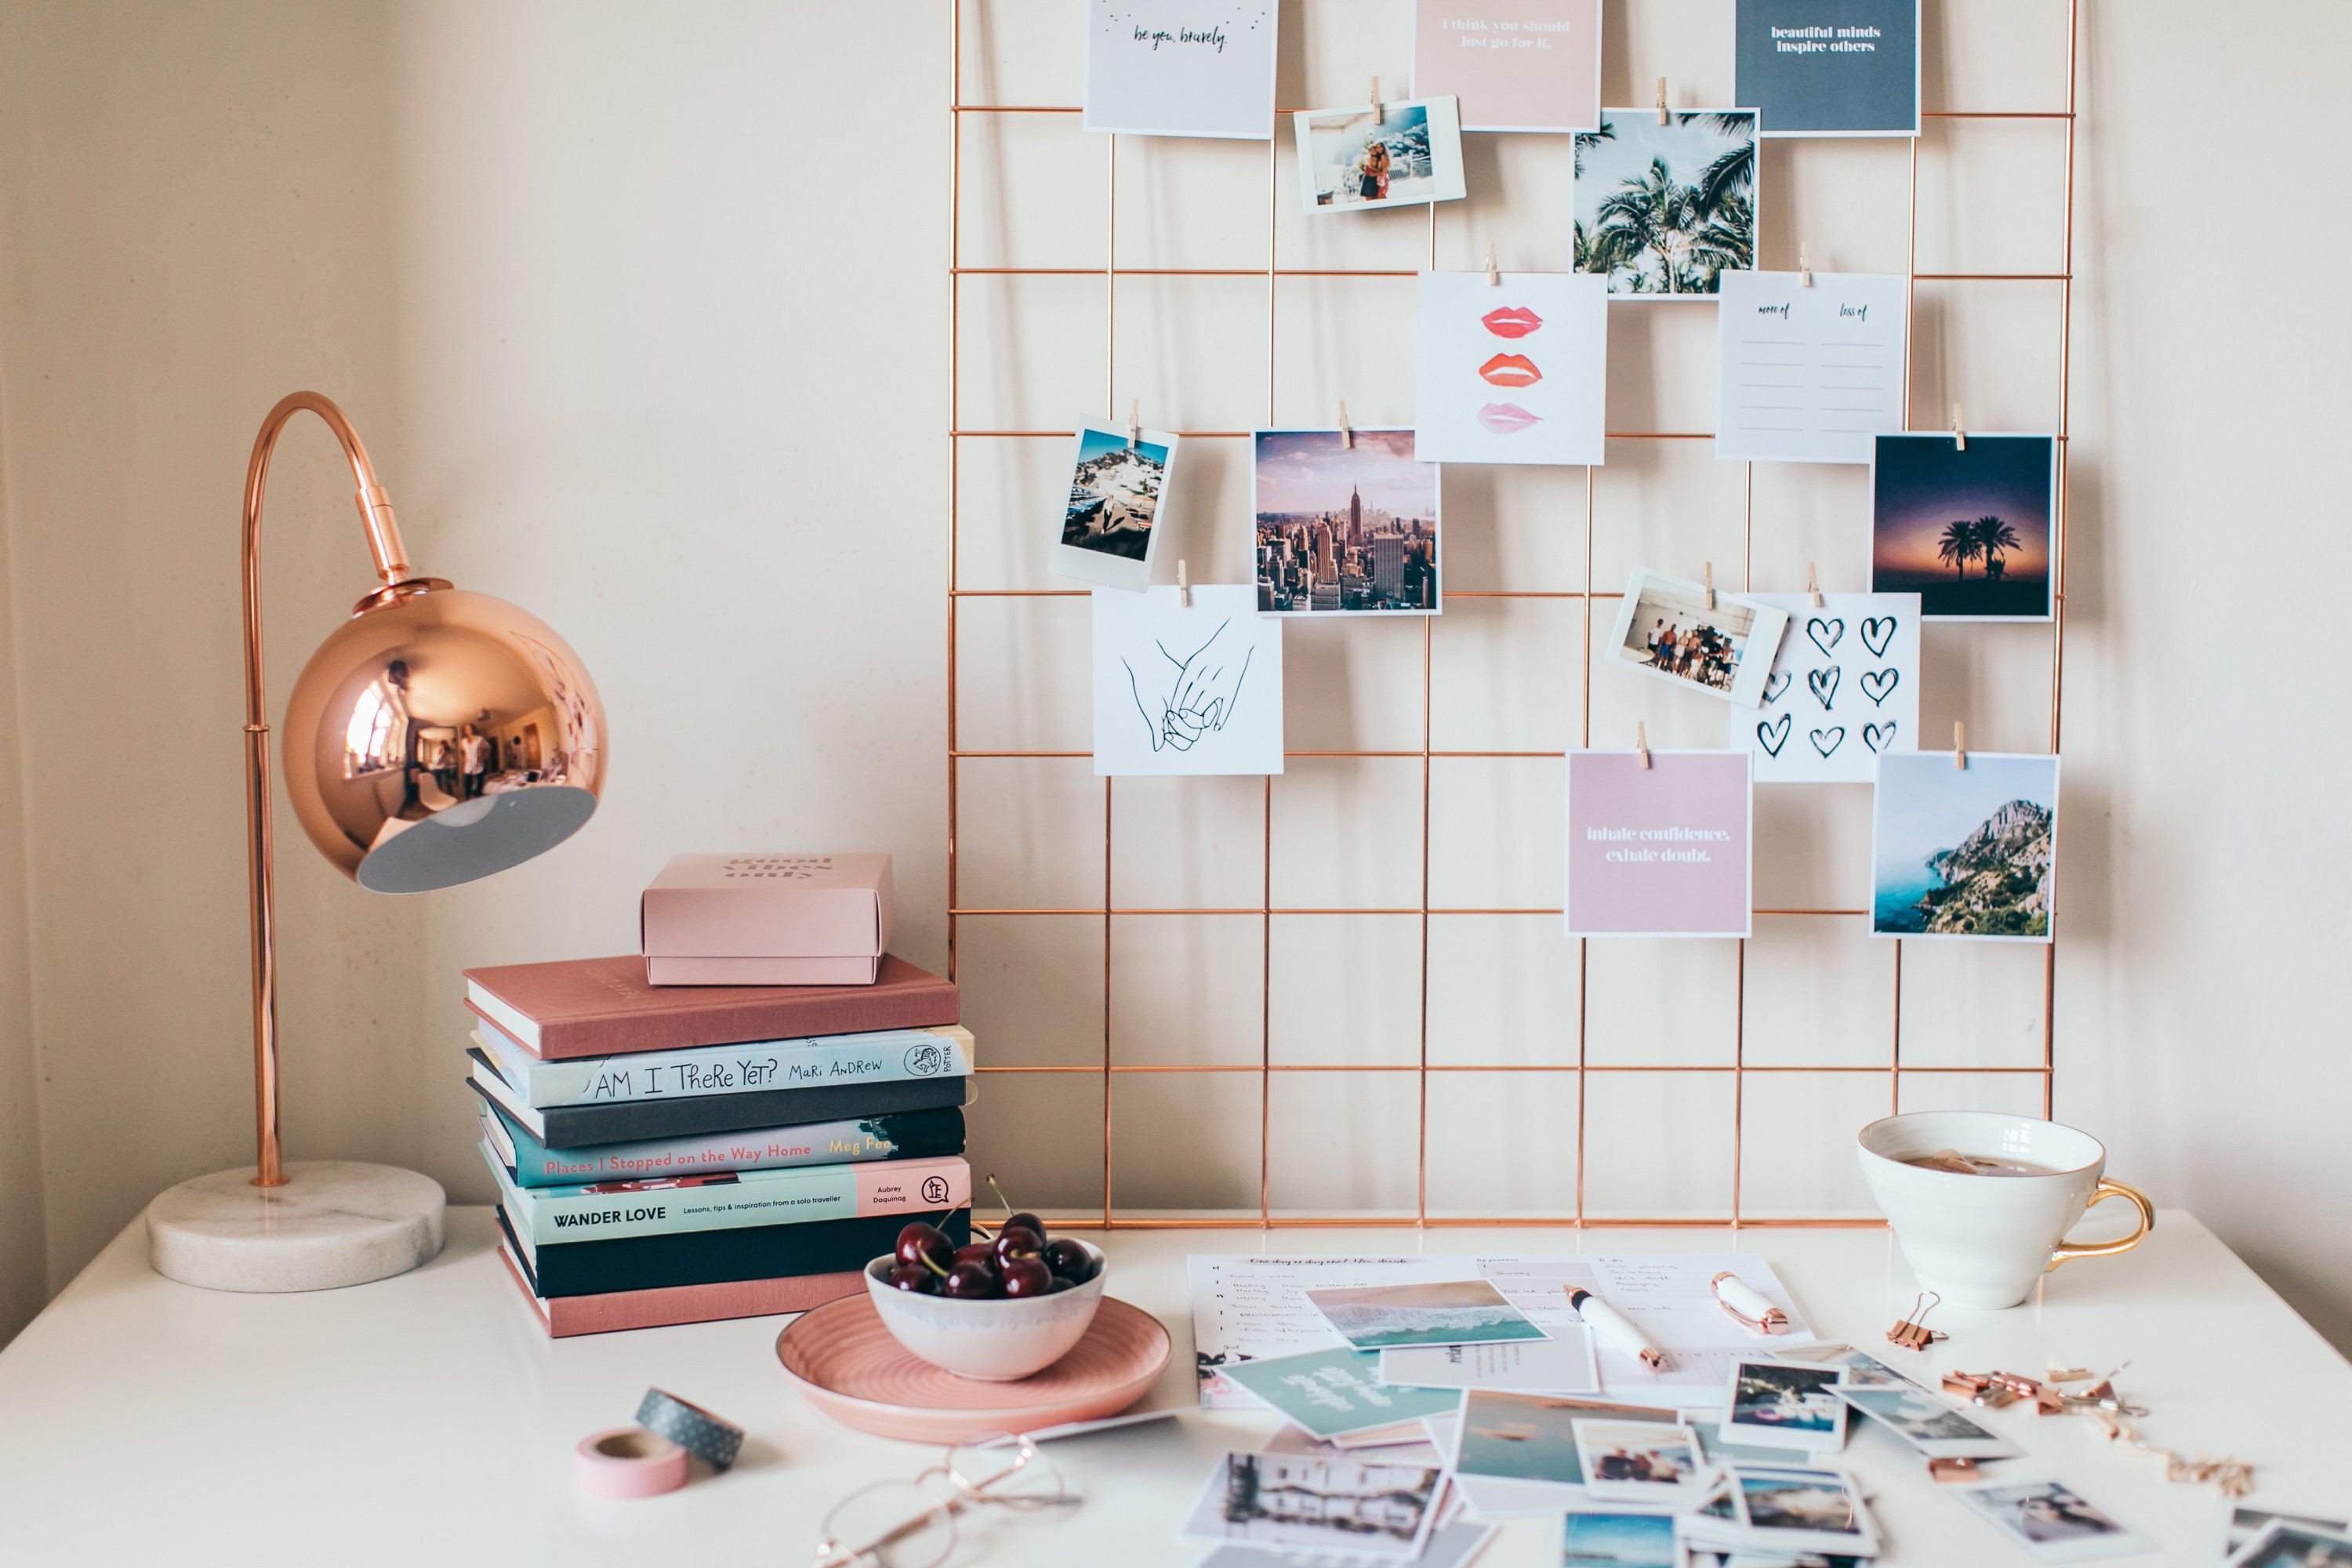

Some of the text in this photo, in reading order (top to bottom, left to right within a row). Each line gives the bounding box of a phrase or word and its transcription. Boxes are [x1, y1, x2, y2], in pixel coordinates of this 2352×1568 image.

[1134, 24, 1148, 41] be
[1452, 19, 1488, 31] think
[1493, 21, 1518, 33] you
[1523, 20, 1570, 32] should
[1771, 26, 1881, 38] beautiful minds
[1461, 35, 1551, 49] just go for it.
[1777, 40, 1875, 54] inspire others
[1758, 303, 1790, 320] more of
[1839, 303, 1867, 321] less of
[1587, 826, 1731, 841] inhale confidence.
[1606, 848, 1711, 862] exhale doubt.
[595, 1072, 631, 1098] AM
[644, 1067, 664, 1094] I
[829, 1136, 892, 1156] Meg Fee
[545, 1143, 811, 1175] Places I Stopped on the Way Home
[684, 1206, 712, 1214] Lessons,
[735, 1200, 771, 1210] inspiration
[812, 1196, 841, 1204] traveller
[554, 1207, 666, 1228] WANDER LOVE
